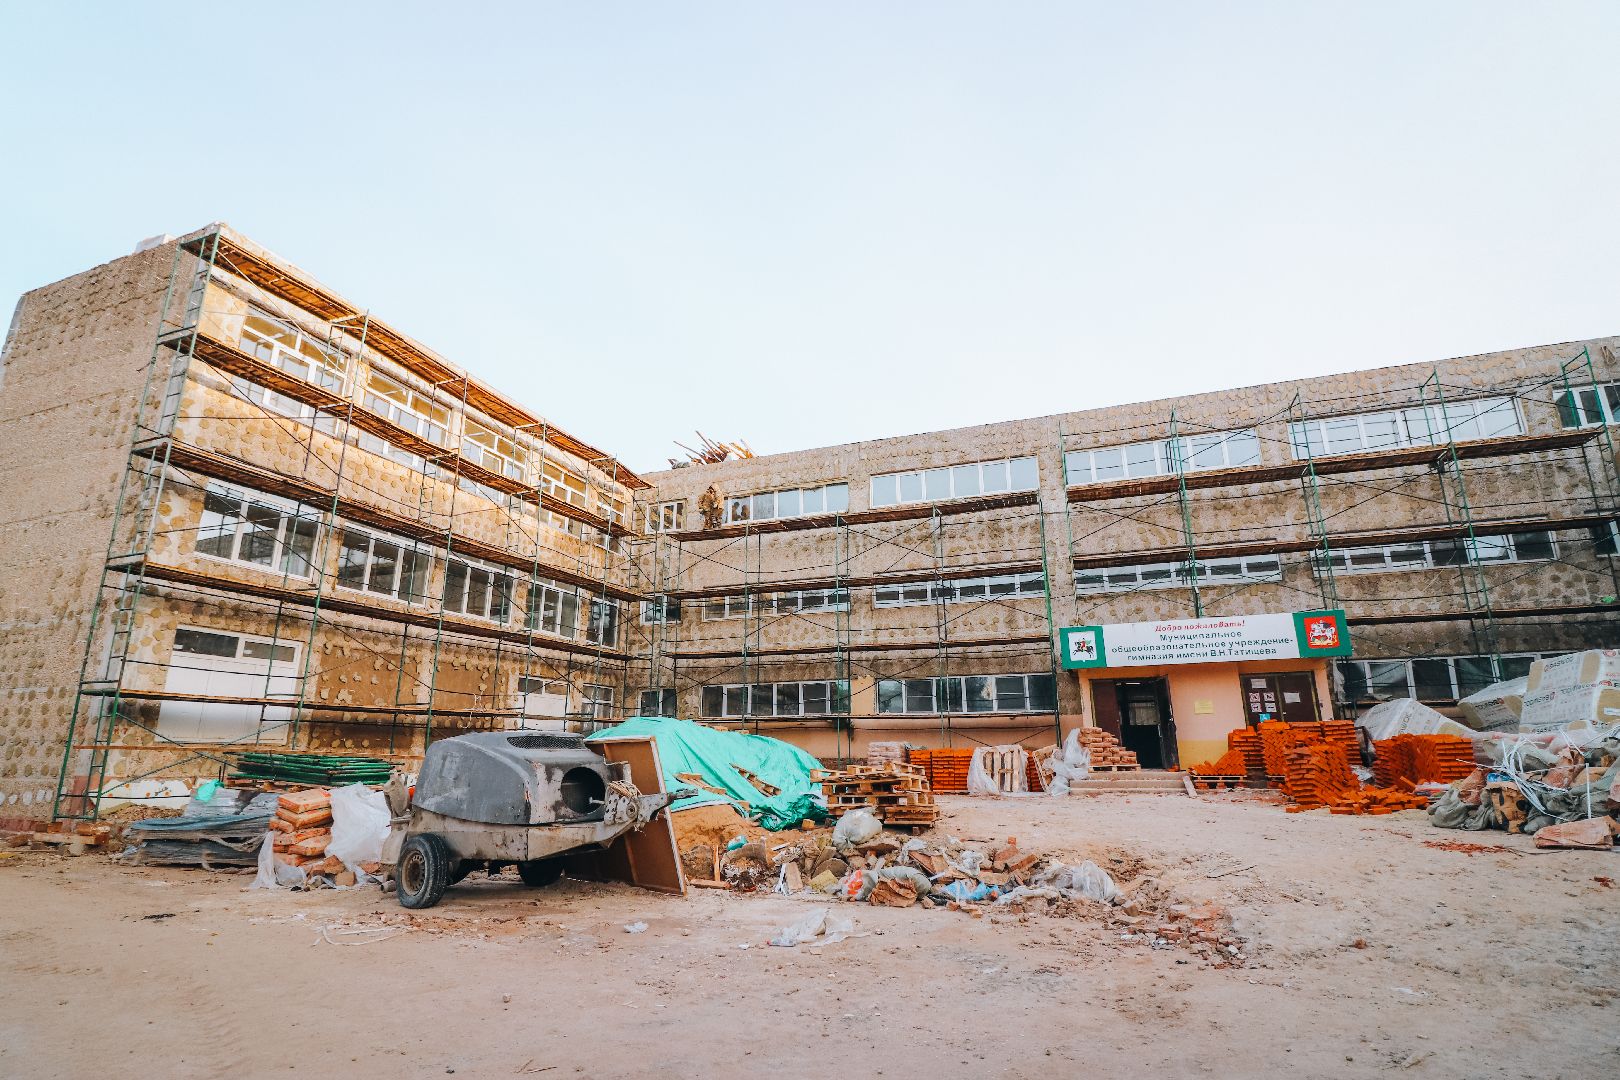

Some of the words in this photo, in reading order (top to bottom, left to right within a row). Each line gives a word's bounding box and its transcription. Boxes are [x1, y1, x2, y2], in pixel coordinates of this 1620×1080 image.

[1155, 625, 1182, 633] Добро
[1184, 620, 1245, 631] пожаловать!
[1160, 631, 1242, 642] Муниципальное
[1111, 641, 1226, 653] общеобразовательное
[1228, 637, 1293, 648] учреждение-
[1127, 652, 1174, 661] гимназия
[1176, 651, 1208, 659] имени
[1210, 648, 1277, 658] В.Н.Татищева
